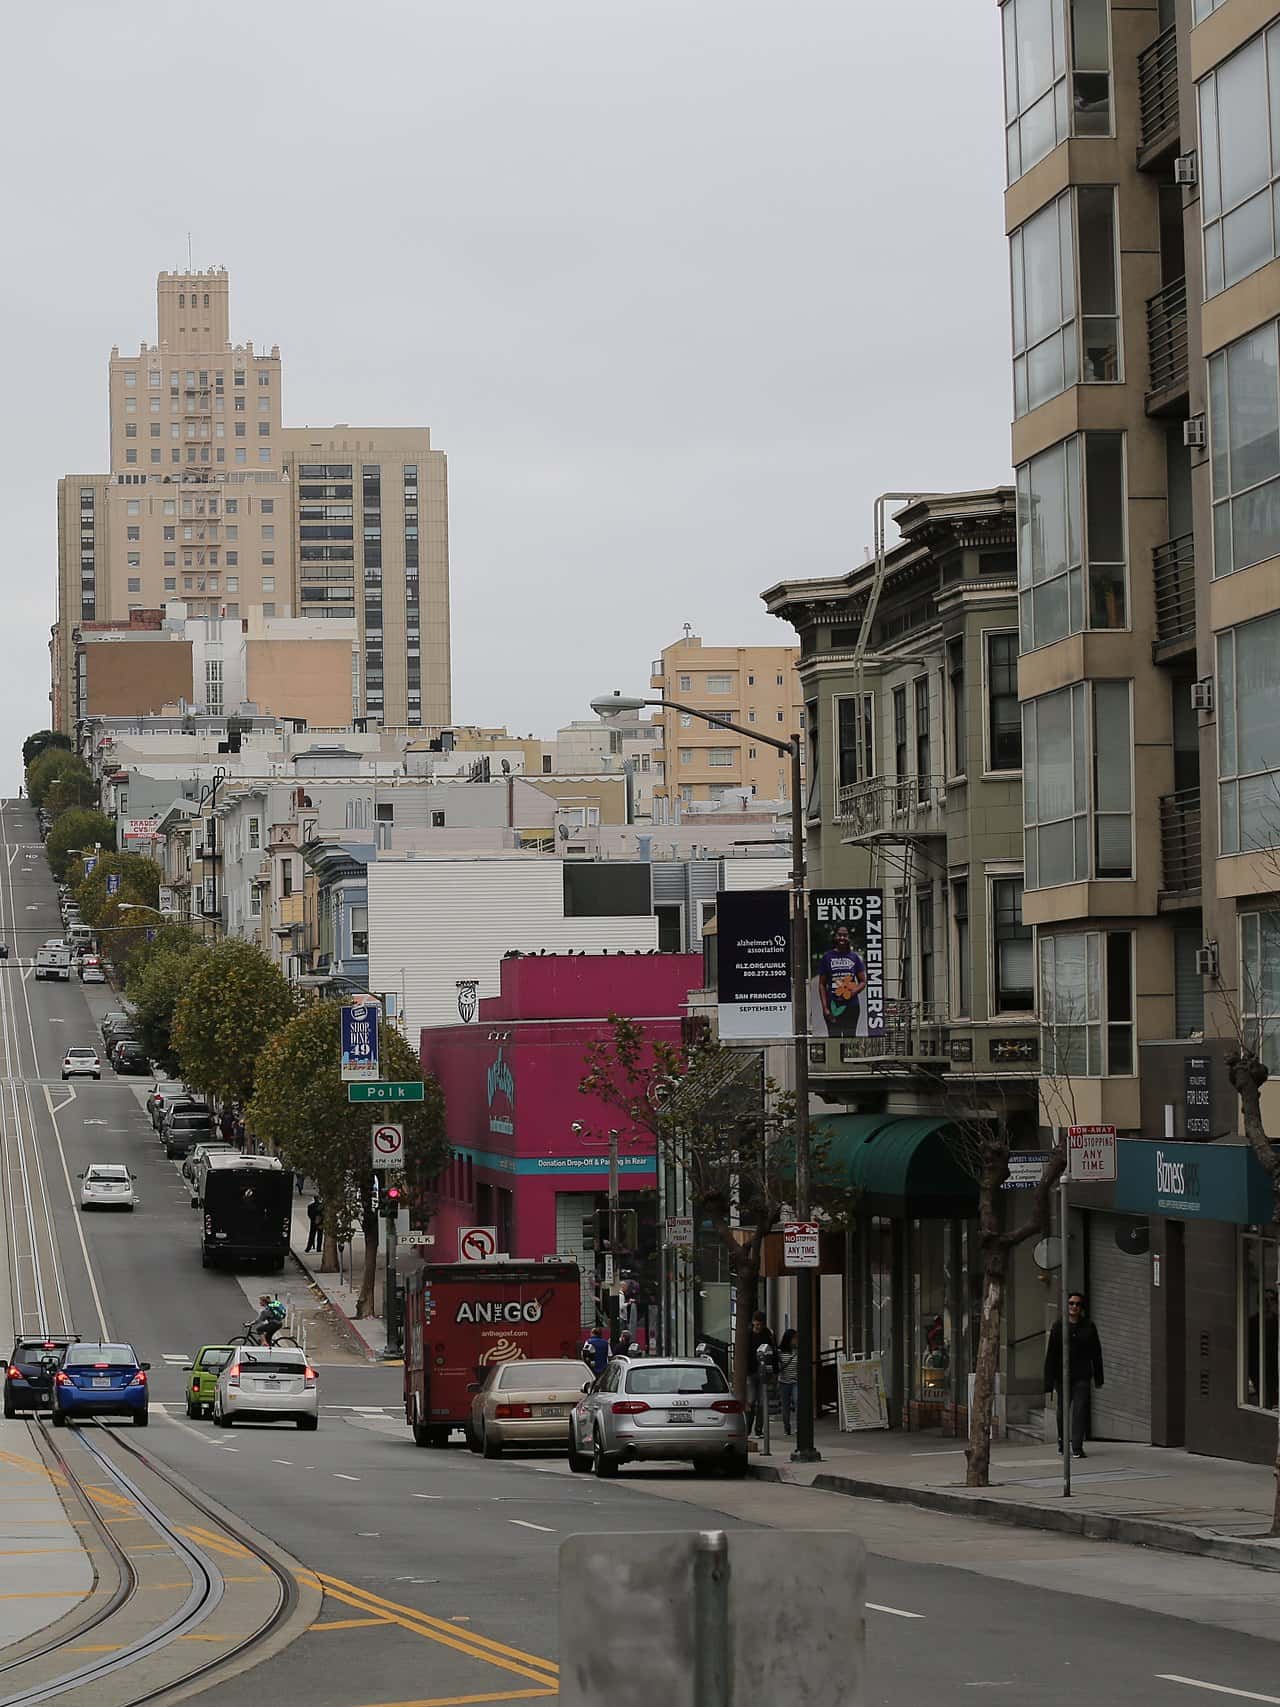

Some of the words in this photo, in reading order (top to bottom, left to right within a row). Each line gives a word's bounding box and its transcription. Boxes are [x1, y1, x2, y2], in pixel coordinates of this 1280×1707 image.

[816, 897, 846, 905] WALK
[848, 897, 863, 905] TO
[817, 906, 863, 921] END
[866, 895, 884, 1030] ALZHEIMER'S
[350, 1032, 370, 1044] DINE
[350, 1044, 371, 1055] 49
[367, 1087, 405, 1097] Polk
[1070, 1135, 1083, 1148] NO
[1084, 1136, 1113, 1147] STOPPING
[1083, 1150, 1102, 1159] ANY
[538, 1159, 566, 1167] Donation
[567, 1159, 593, 1167] Drop-Off
[631, 1157, 647, 1165] Rear
[1082, 1160, 1105, 1170] TIME
[1156, 1151, 1185, 1195] Bizness
[787, 1246, 800, 1254] ANY
[801, 1246, 816, 1254] TIME
[456, 1302, 492, 1323] AN
[494, 1303, 503, 1323] THE
[504, 1302, 543, 1322] GO
